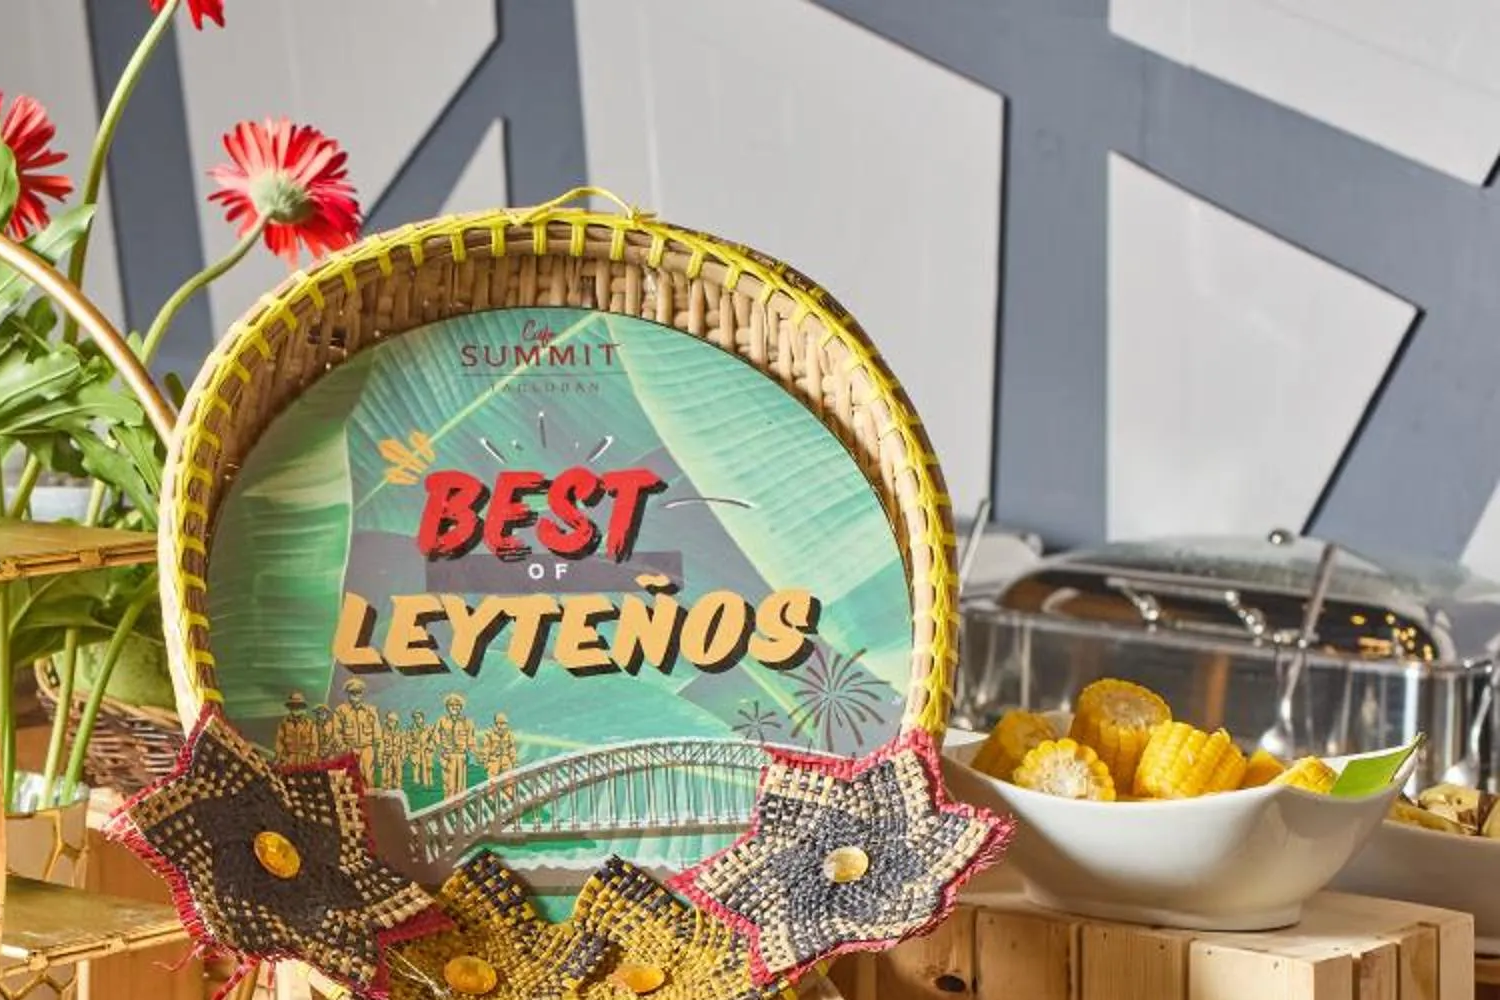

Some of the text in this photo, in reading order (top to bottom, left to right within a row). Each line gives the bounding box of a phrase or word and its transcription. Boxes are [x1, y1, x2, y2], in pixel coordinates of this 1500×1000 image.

[461, 343, 621, 367] SUMMIT
[418, 465, 668, 563] BEST
[527, 563, 569, 580] OF
[332, 573, 819, 678] LEYTEÑOS
